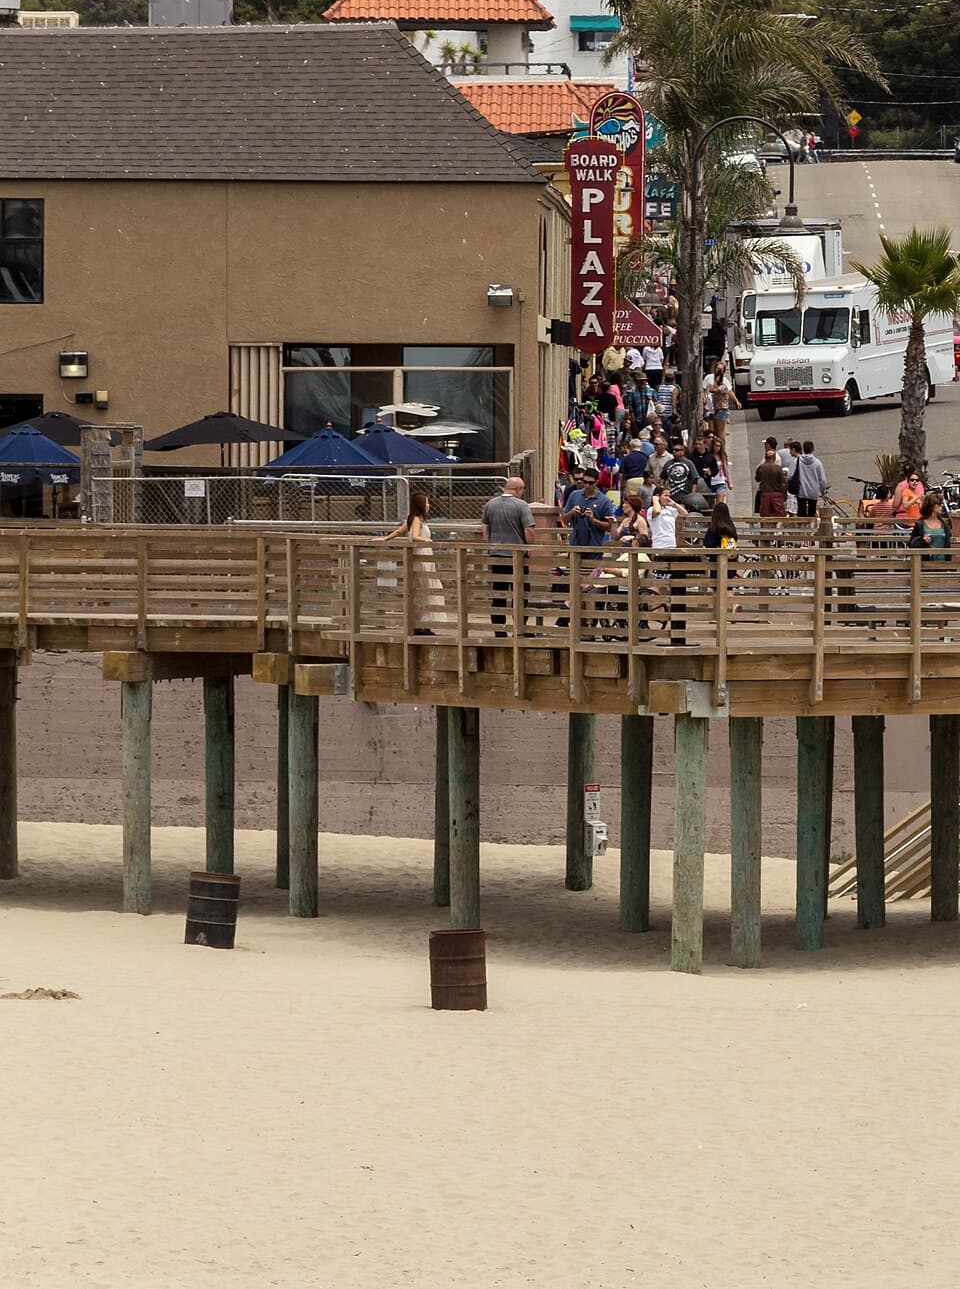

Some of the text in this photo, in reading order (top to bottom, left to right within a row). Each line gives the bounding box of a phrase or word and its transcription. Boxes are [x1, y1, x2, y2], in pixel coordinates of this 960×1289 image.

[570, 154, 618, 167] BOARD
[576, 169, 613, 182] WALK
[579, 188, 605, 337] PLAZA
[613, 335, 659, 344] PUCCINO
